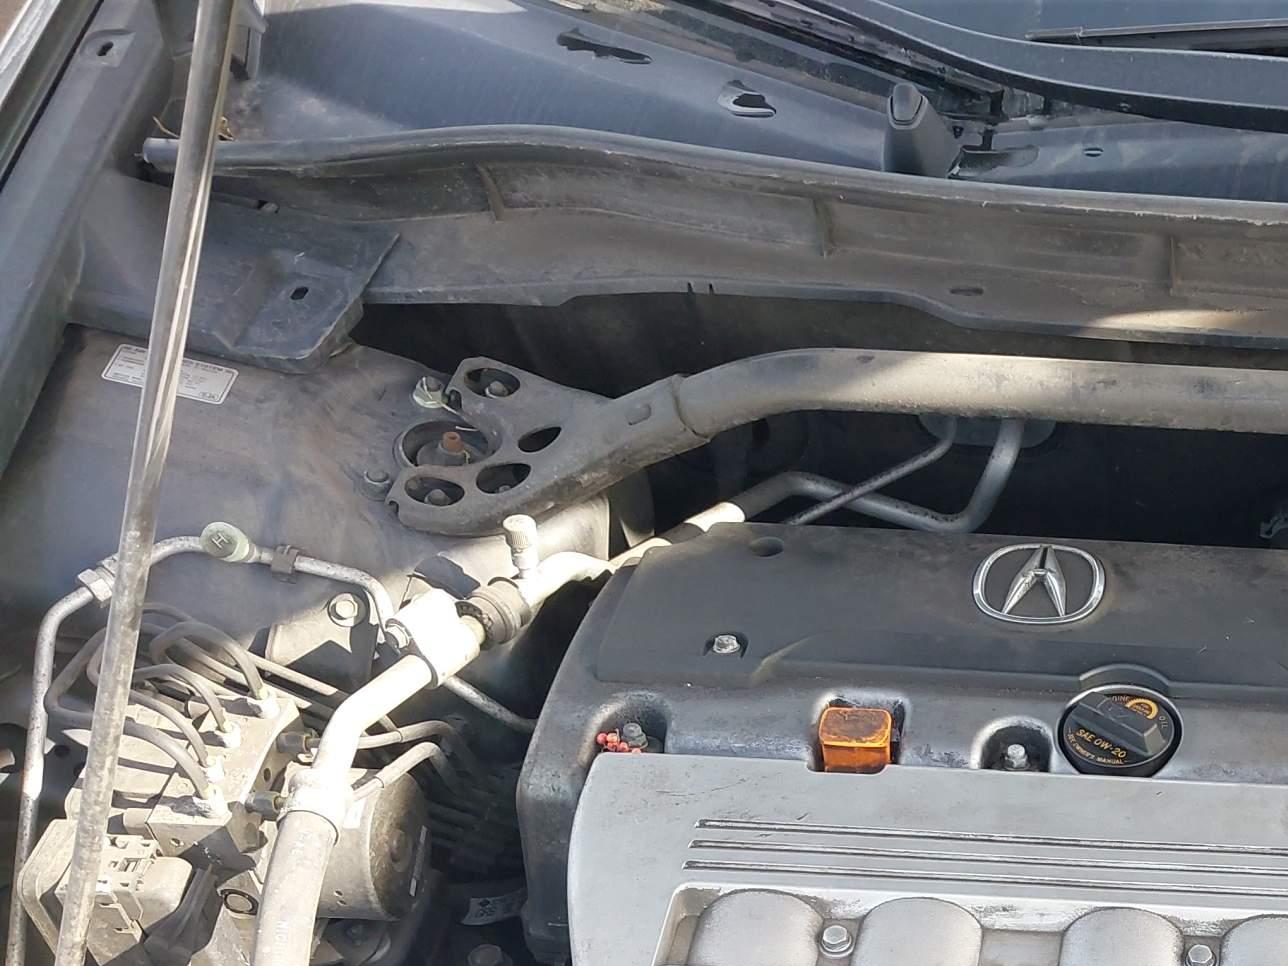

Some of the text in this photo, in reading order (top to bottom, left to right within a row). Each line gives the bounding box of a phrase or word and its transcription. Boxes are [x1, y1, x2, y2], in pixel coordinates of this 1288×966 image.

[1158, 715, 1169, 729] OIL
[1076, 729, 1127, 758] SAE 0W-20
